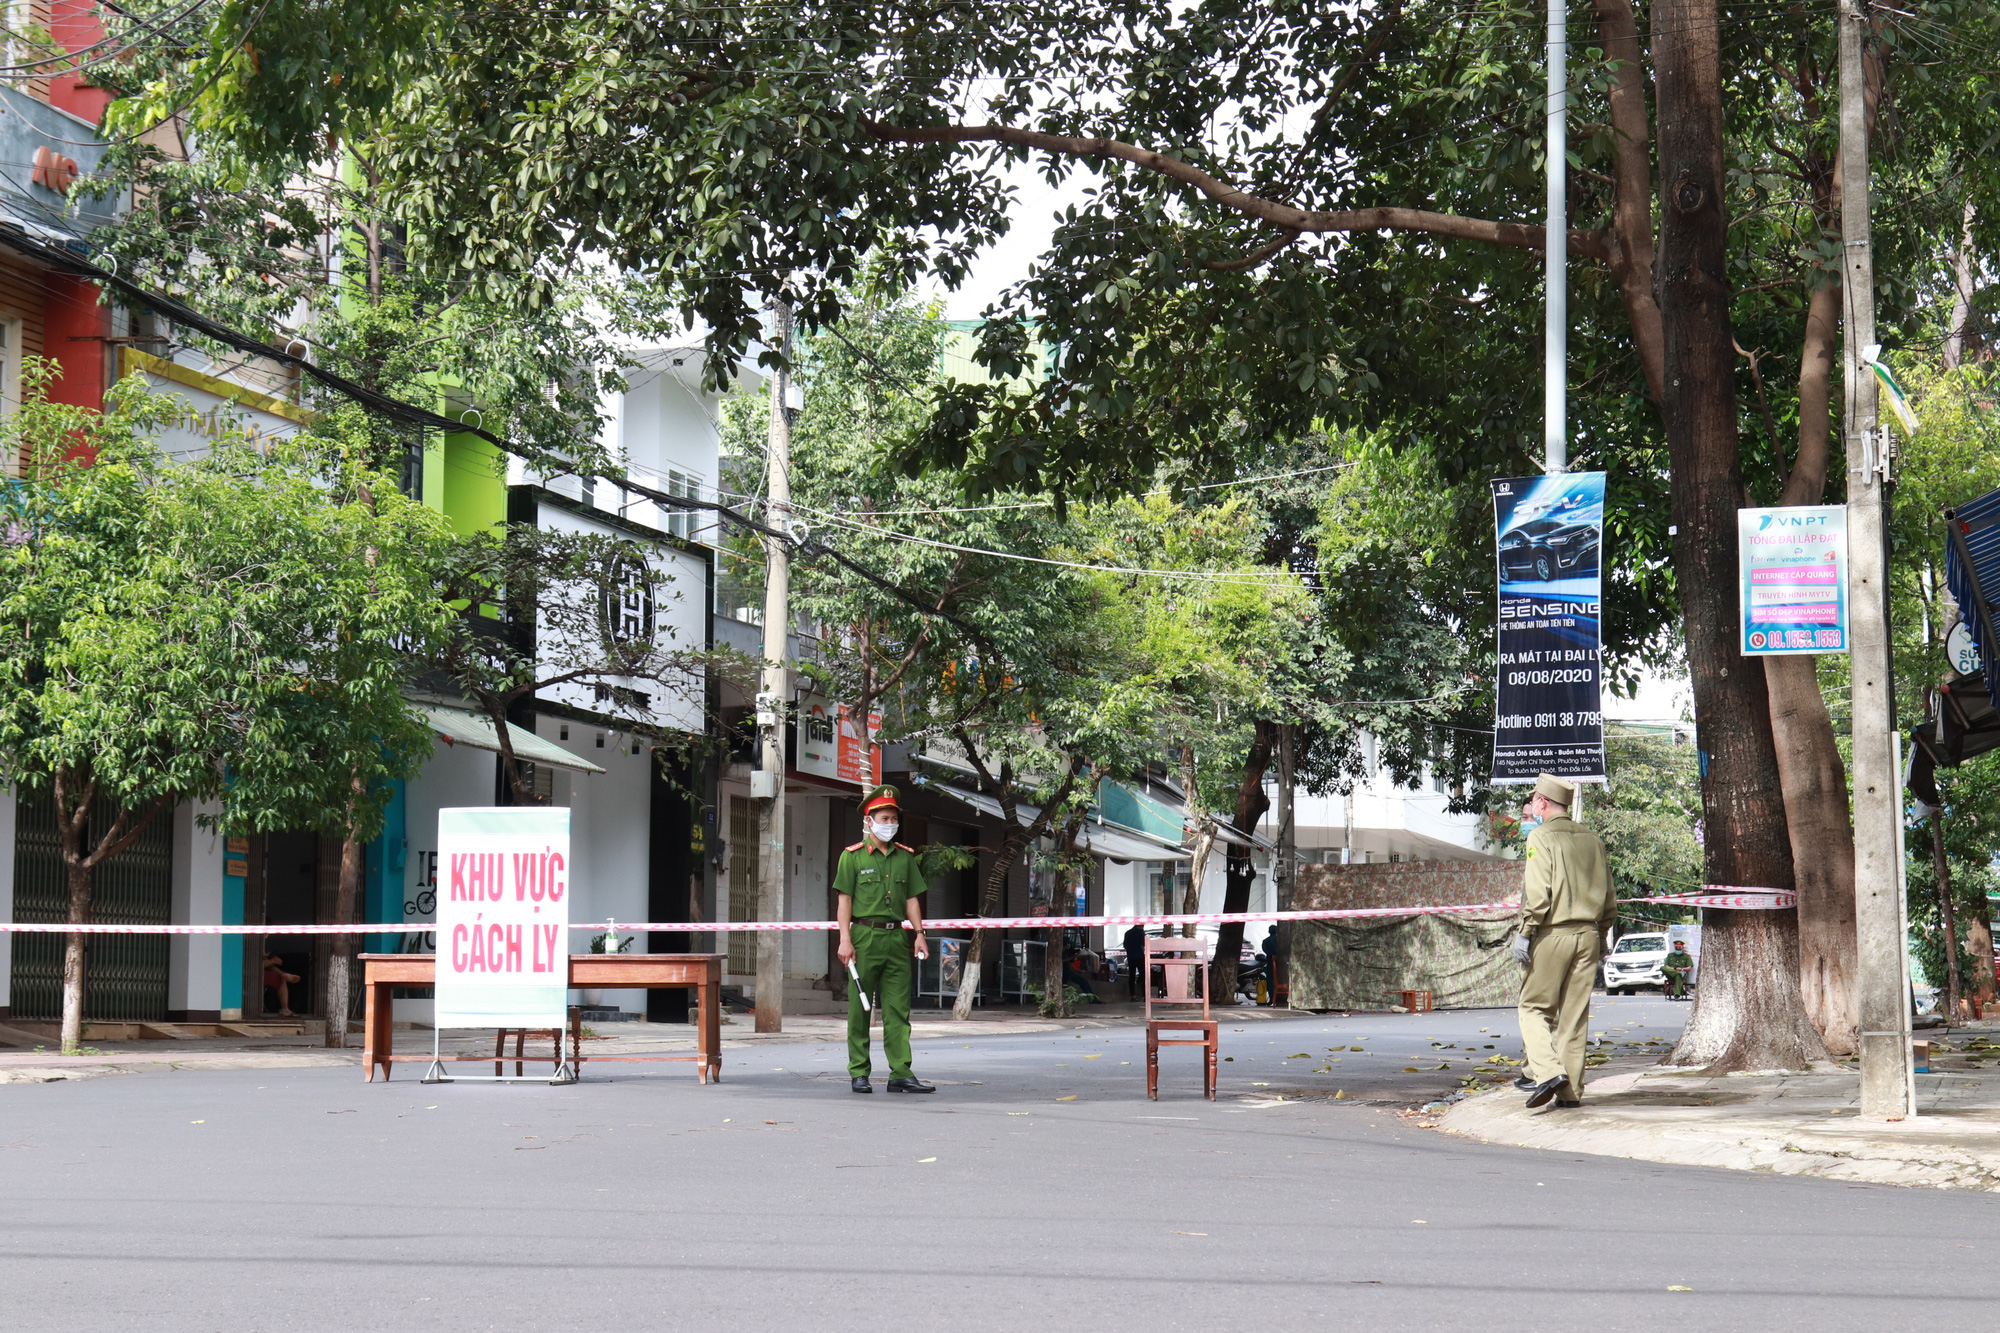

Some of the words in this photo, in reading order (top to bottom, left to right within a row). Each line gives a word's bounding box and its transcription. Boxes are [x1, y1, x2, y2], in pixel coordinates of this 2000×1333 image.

[1778, 516, 1827, 526] VNPT
[1753, 572, 1790, 580] INTERNET
[1527, 620, 1534, 629] AN
[1500, 653, 1516, 664] RA
[1545, 650, 1561, 663] TẠI
[1565, 649, 1585, 662] ĐẠI
[1508, 669, 1592, 686] 08/08/2020
[1497, 714, 1532, 728] Hotline
[1534, 713, 1556, 727] 0911
[1560, 712, 1573, 727] 38
[1576, 711, 1602, 726] 7799
[450, 853, 504, 902] KHU
[513, 845, 564, 913] VỰC
[452, 912, 522, 973] CÁCH
[532, 924, 559, 973] LY
